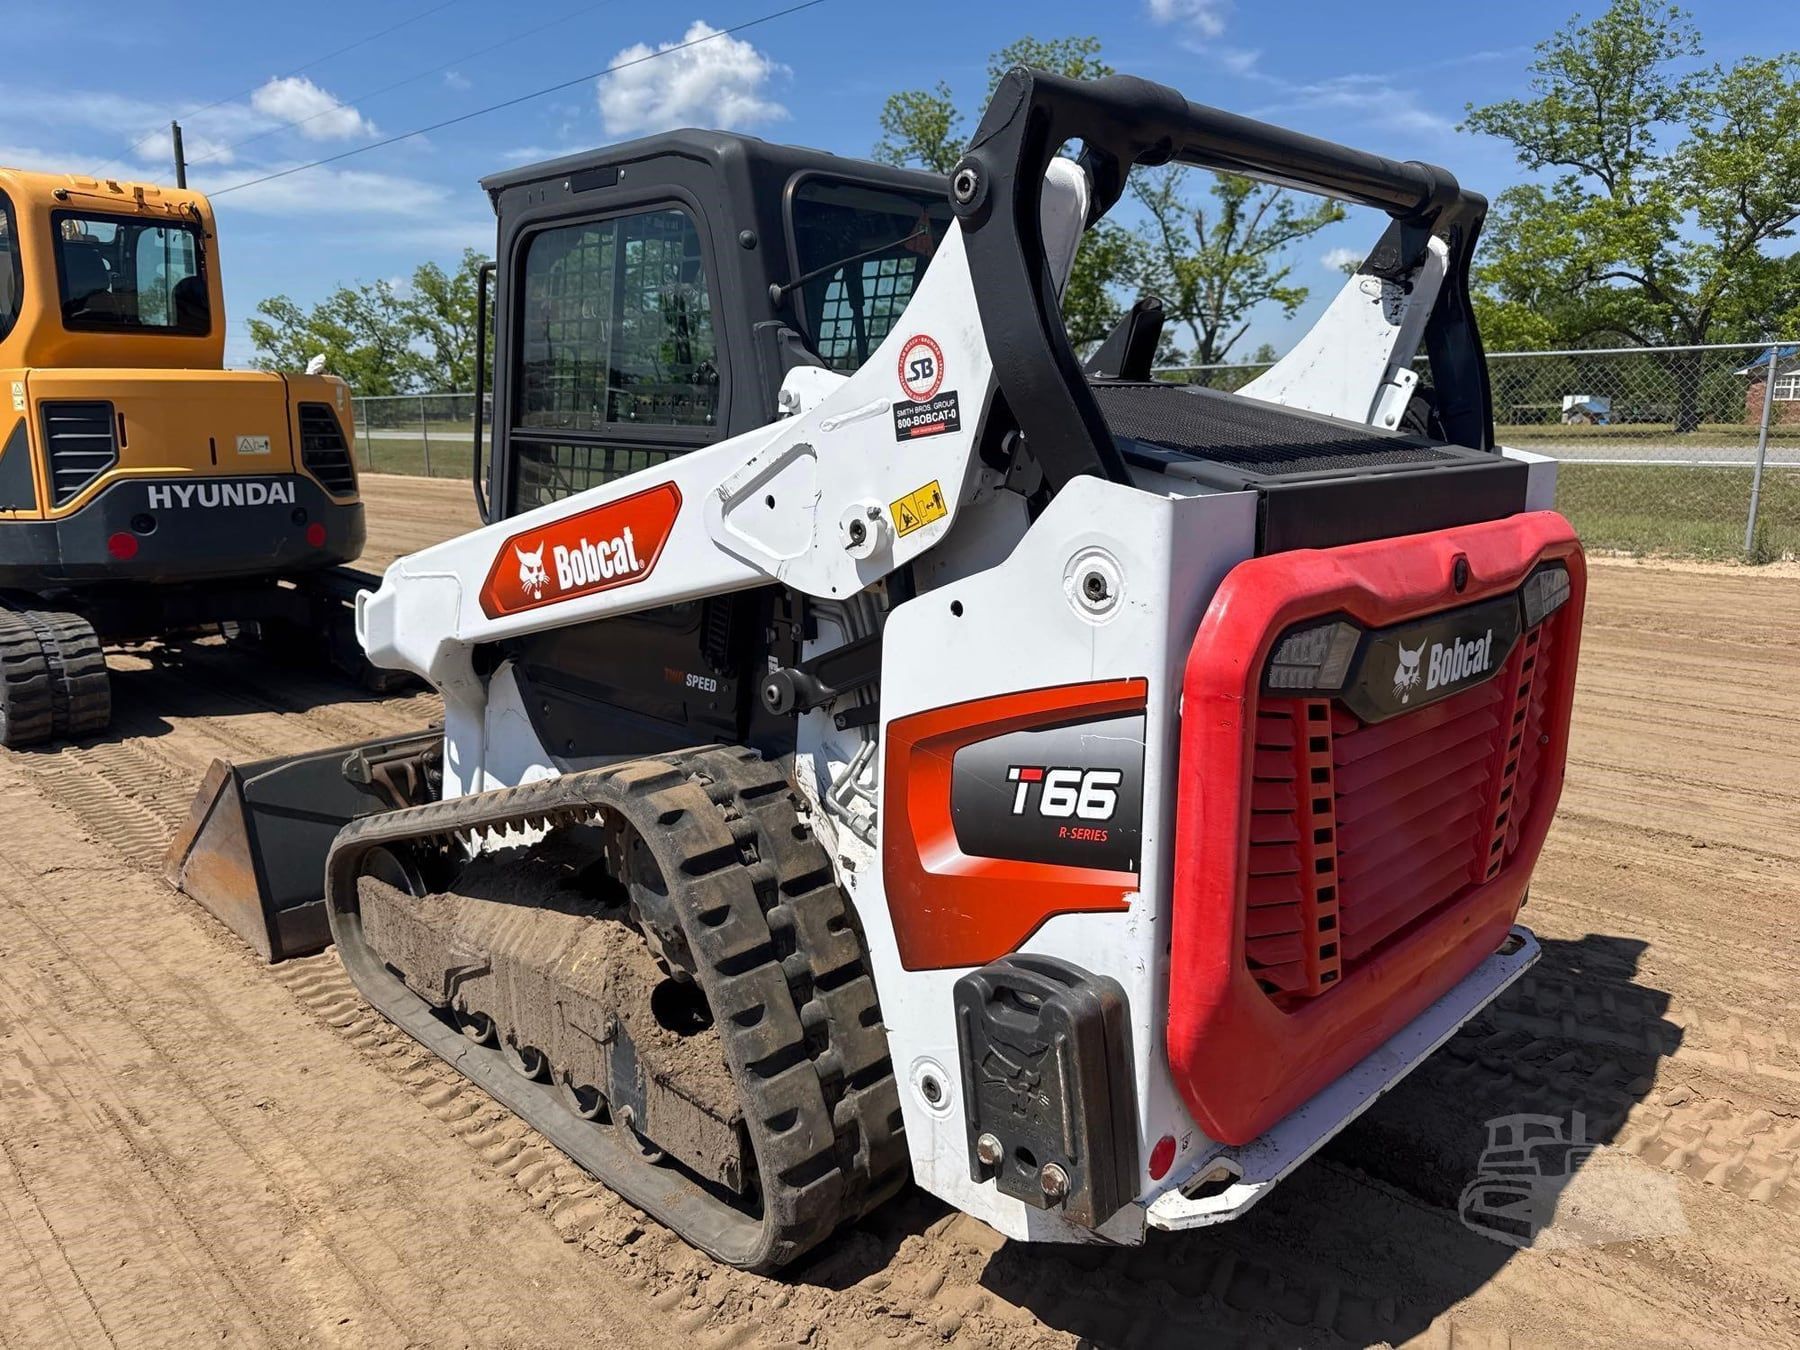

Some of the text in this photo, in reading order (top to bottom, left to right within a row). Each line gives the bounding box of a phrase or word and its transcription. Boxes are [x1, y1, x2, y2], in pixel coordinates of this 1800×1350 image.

[906, 357, 934, 382] SB
[896, 407, 914, 418] SMITH
[933, 399, 955, 410] GROUP
[897, 409, 957, 429] 800-BOBCAT-0
[147, 481, 296, 509] HYUNDAI
[552, 526, 640, 590] Bobcat
[1426, 628, 1493, 691] Bobcat
[685, 673, 717, 692] SPEED
[1007, 766, 1123, 821] T66
[1058, 826, 1109, 842] R-SERIES
